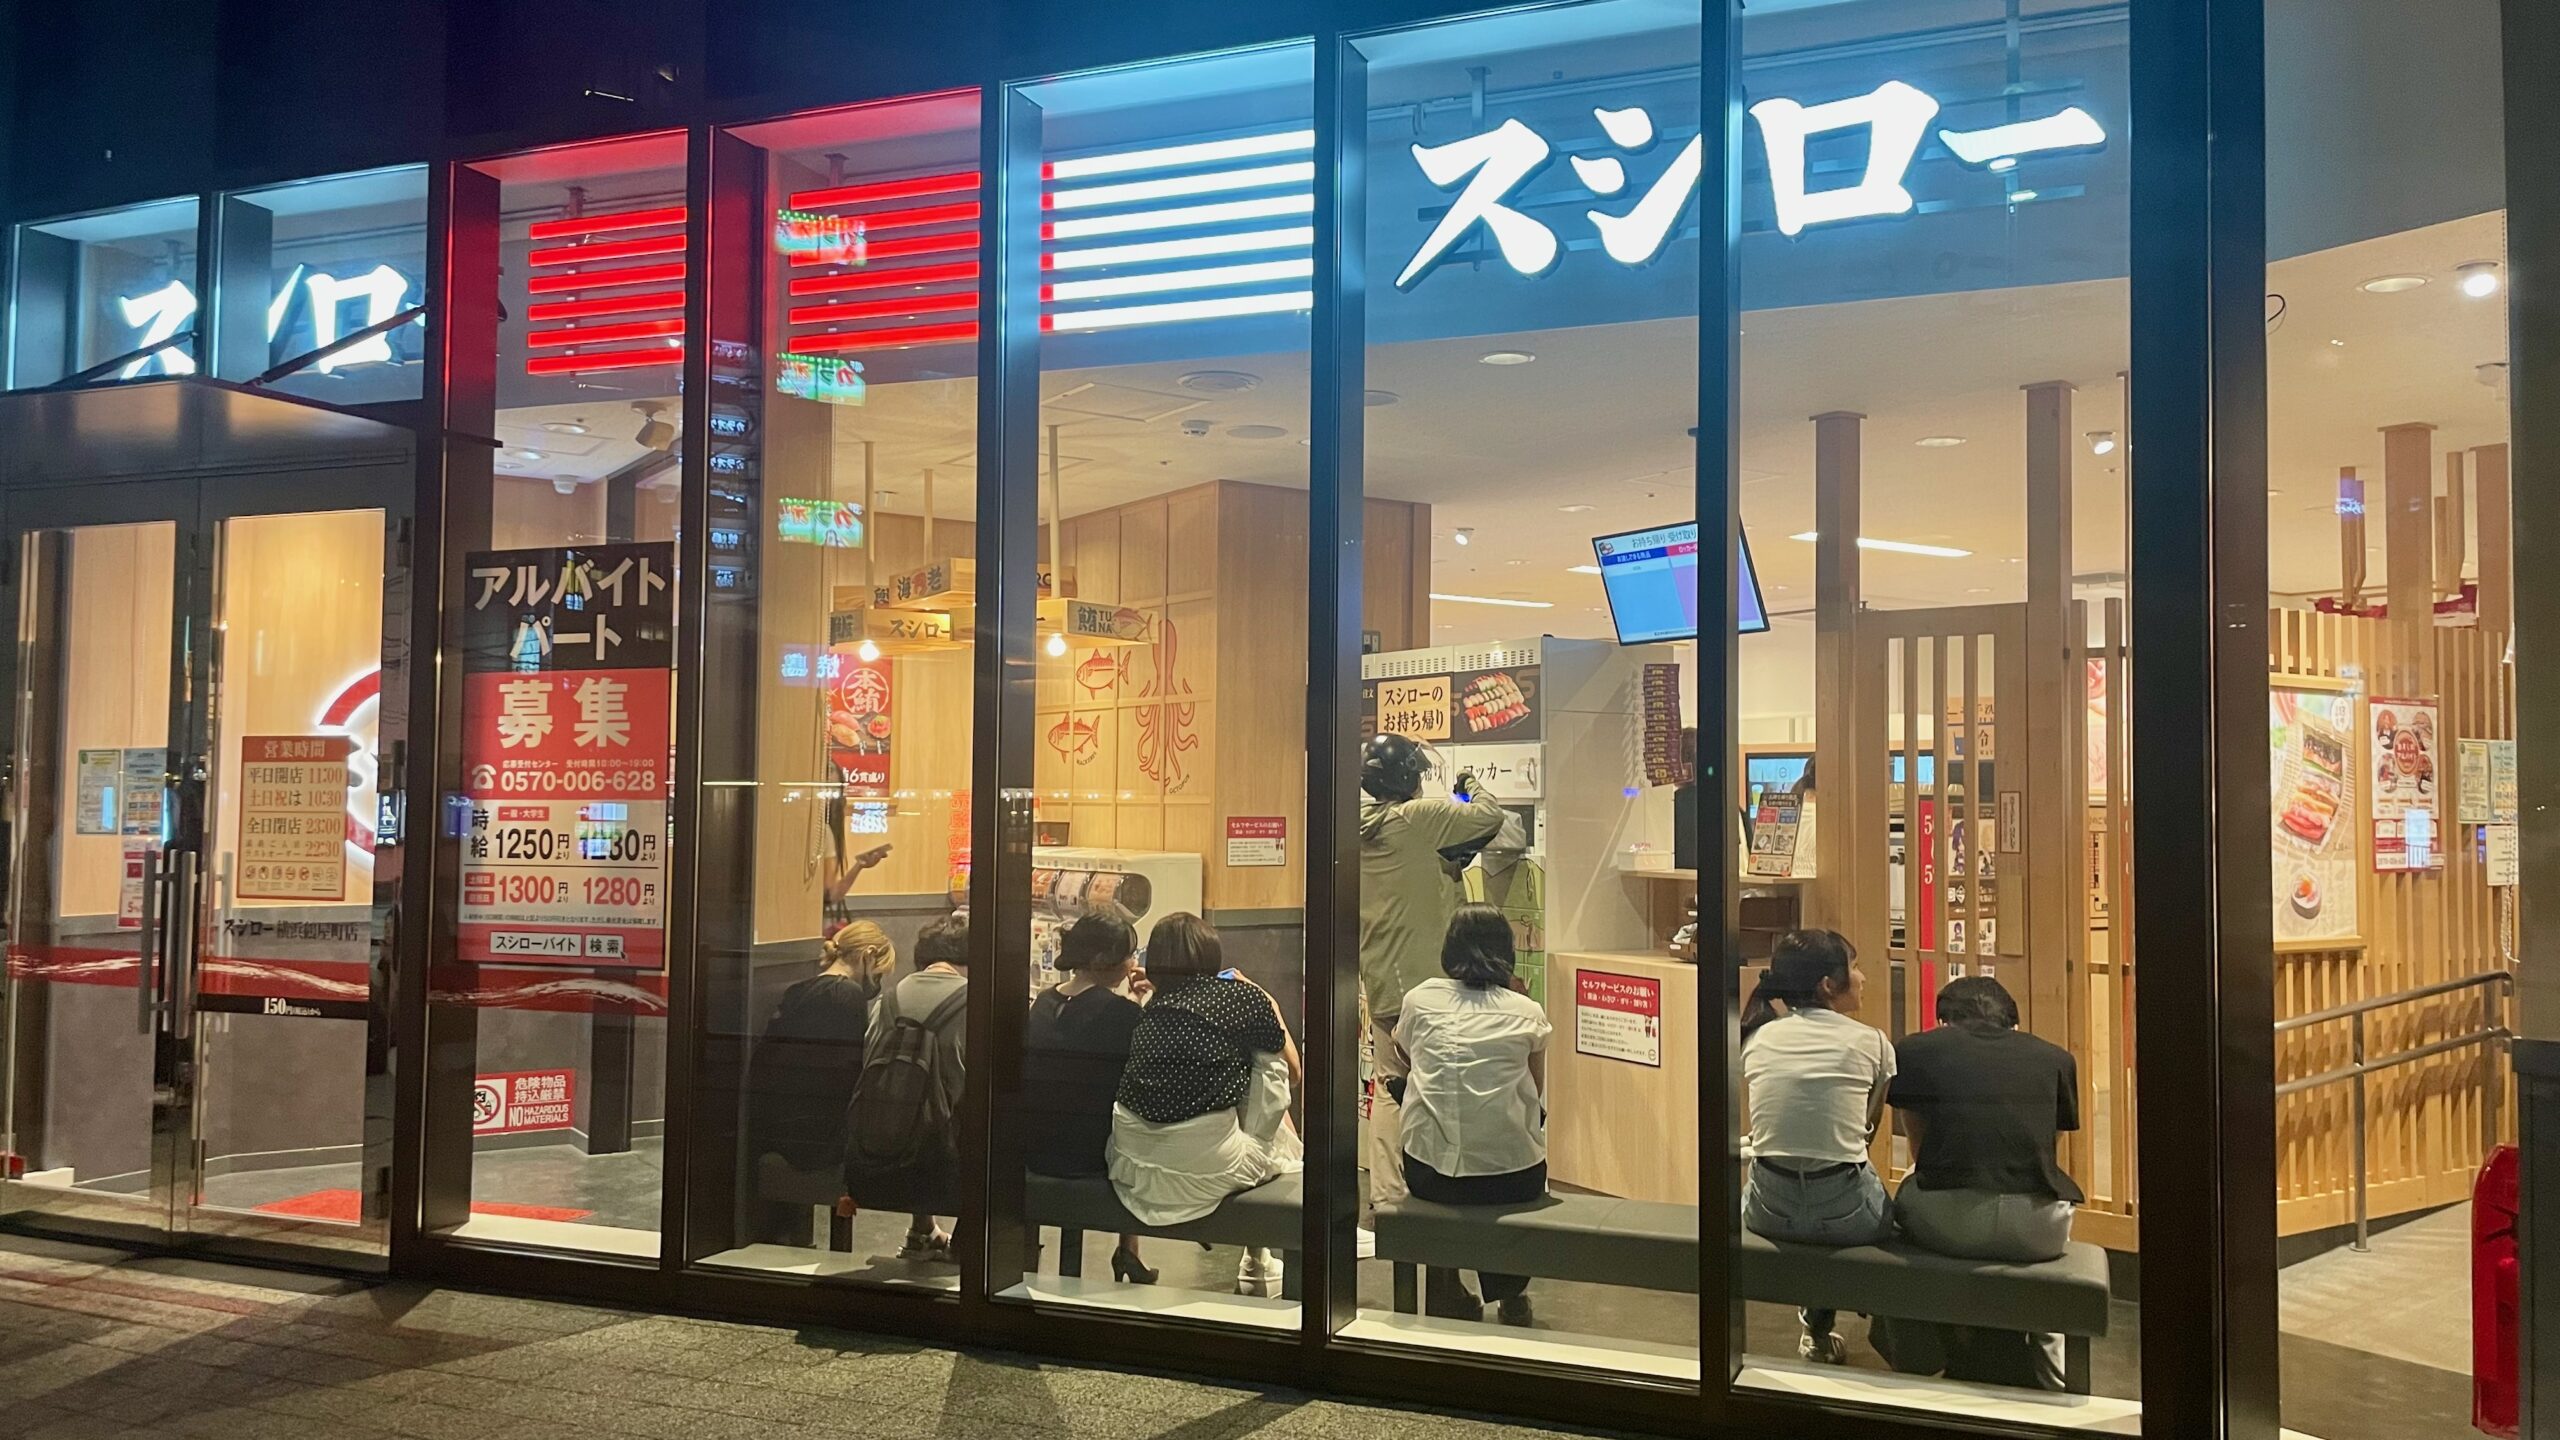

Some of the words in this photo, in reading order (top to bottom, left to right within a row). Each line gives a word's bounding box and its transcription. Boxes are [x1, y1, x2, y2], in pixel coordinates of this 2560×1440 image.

[1394, 80, 2108, 292] スシロー
[472, 557, 666, 611] アルバイト
[509, 614, 622, 661] パート
[890, 618, 951, 639] スシロー
[1384, 686, 1444, 707] スシローの
[497, 677, 631, 749] 募集
[1384, 708, 1444, 733] お持ち帰り
[264, 740, 325, 758] 営業時間
[248, 767, 303, 784] 平日開店
[309, 767, 342, 785] 11:00
[501, 771, 656, 792] 0570-006-628
[249, 790, 302, 807] 土日祝は
[308, 790, 342, 807] 10:30
[247, 817, 301, 835] 全日閉店
[306, 817, 341, 835] 23:00
[470, 809, 489, 859] 時給
[305, 840, 340, 858] 22:30
[496, 828, 553, 861] 1250
[498, 875, 555, 905] 1300
[583, 876, 642, 907] 1280
[224, 918, 274, 937] スシロー
[495, 935, 577, 953] スシローバイト
[589, 937, 620, 954] 検索
[1581, 979, 1655, 998] セルフサービスのお願い
[515, 1074, 567, 1090] 危険物品
[514, 1088, 566, 1103] 持込厳禁
[509, 1106, 523, 1127] NO
[524, 1104, 569, 1116] HAZARDOUS
[523, 1113, 569, 1126] MATERIALS
